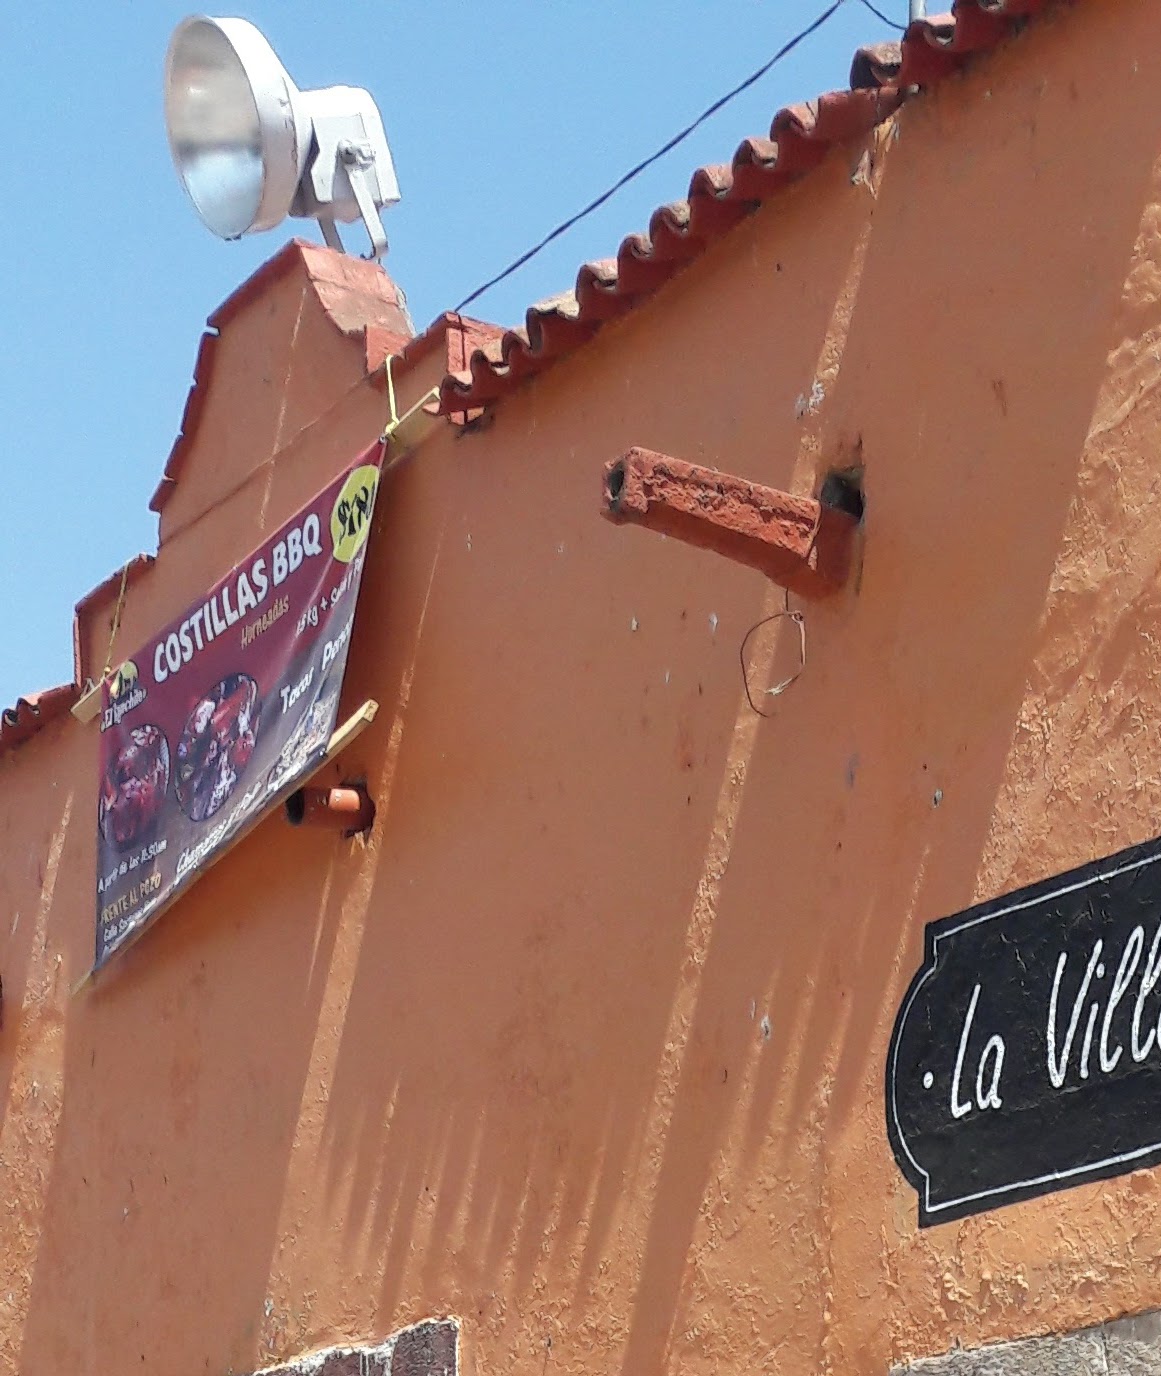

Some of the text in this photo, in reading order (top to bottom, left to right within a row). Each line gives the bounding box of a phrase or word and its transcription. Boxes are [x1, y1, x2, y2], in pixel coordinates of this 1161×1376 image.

[154, 558, 269, 683] COSTILLAS
[273, 514, 322, 587] BBQ
[241, 595, 290, 650] Horneadas
[952, 984, 1006, 1119] La
